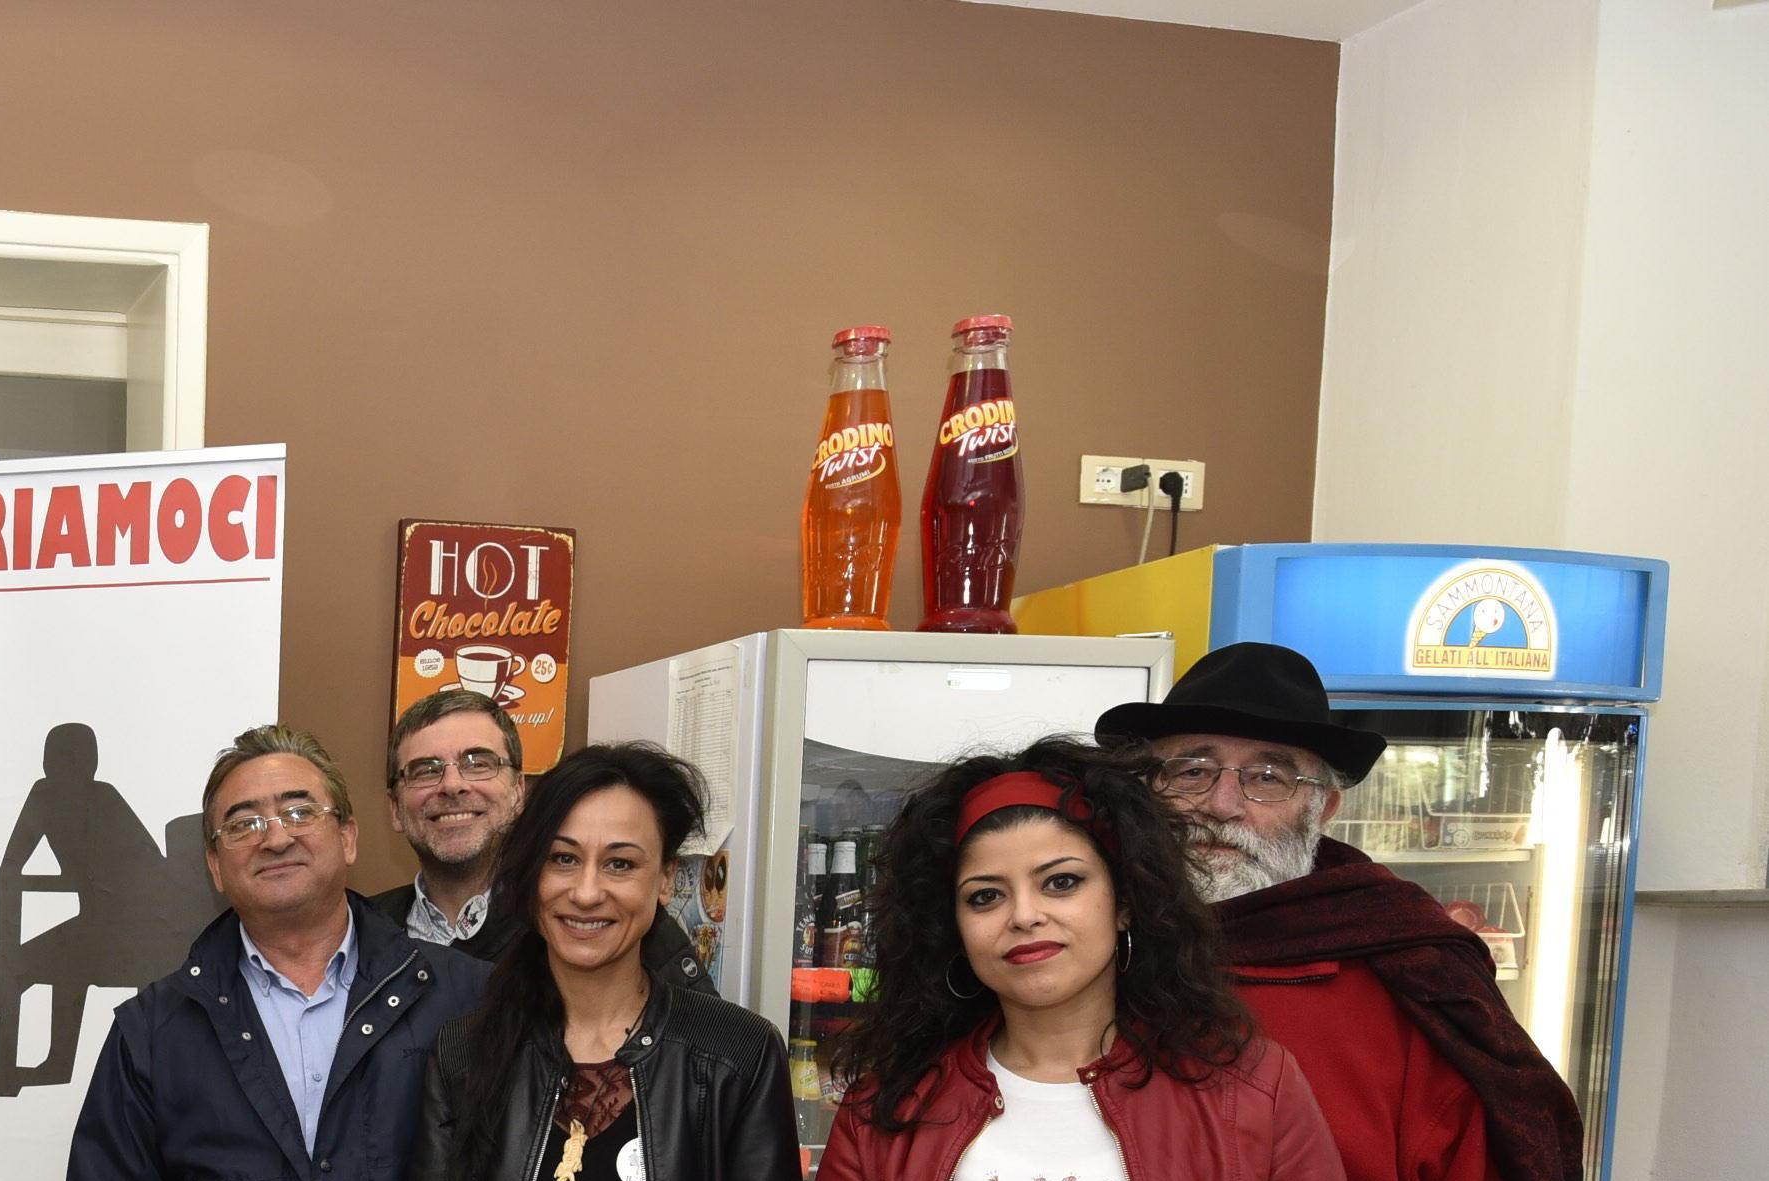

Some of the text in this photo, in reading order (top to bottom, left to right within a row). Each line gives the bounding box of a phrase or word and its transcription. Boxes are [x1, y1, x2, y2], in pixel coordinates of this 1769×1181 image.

[939, 400, 1015, 445] CRODIN
[429, 540, 550, 601] HOT
[409, 599, 562, 640] Chocolate
[1426, 574, 1544, 633] SAMMONTANA
[1416, 649, 1461, 664] GELATI
[509, 712, 525, 724] ou
